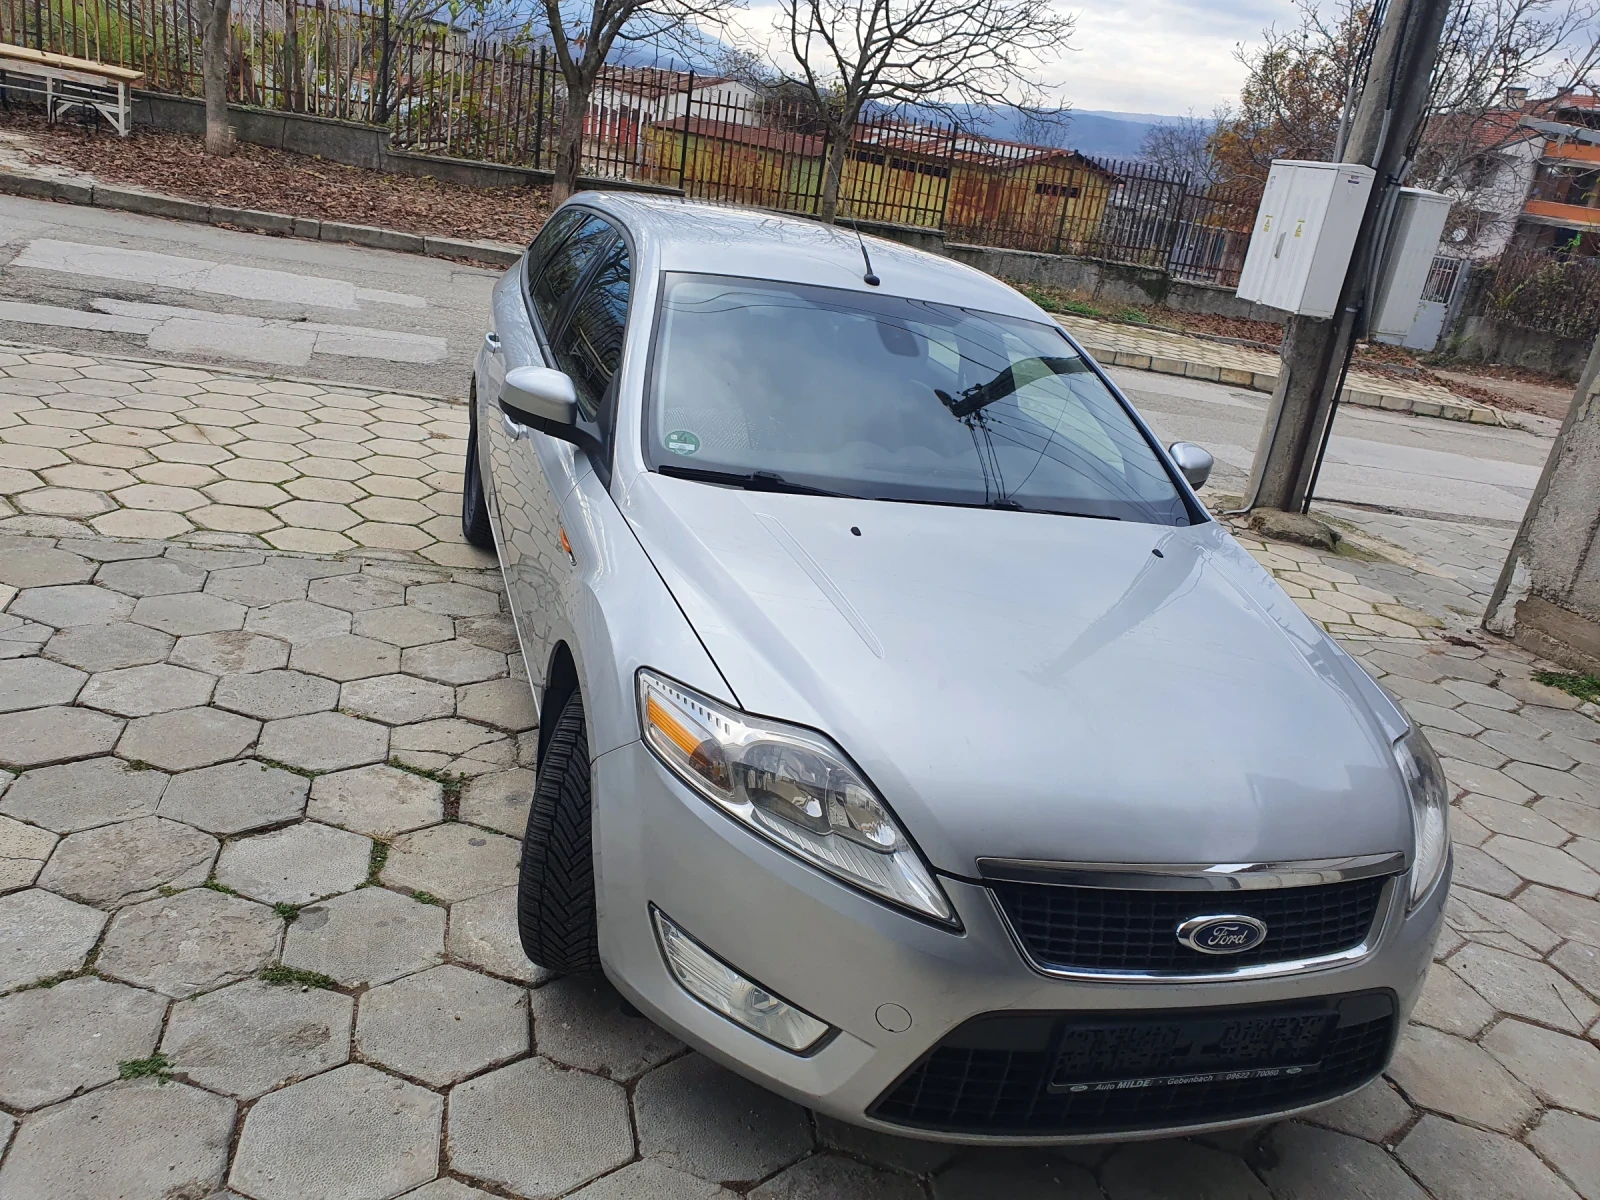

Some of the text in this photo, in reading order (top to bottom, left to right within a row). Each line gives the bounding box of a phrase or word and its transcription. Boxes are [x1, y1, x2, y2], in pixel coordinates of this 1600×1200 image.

[1207, 926, 1248, 945] Ford
[1094, 1082, 1115, 1091] Auto
[1167, 1075, 1213, 1085] Gebenbach
[1226, 1071, 1250, 1080] 09622
